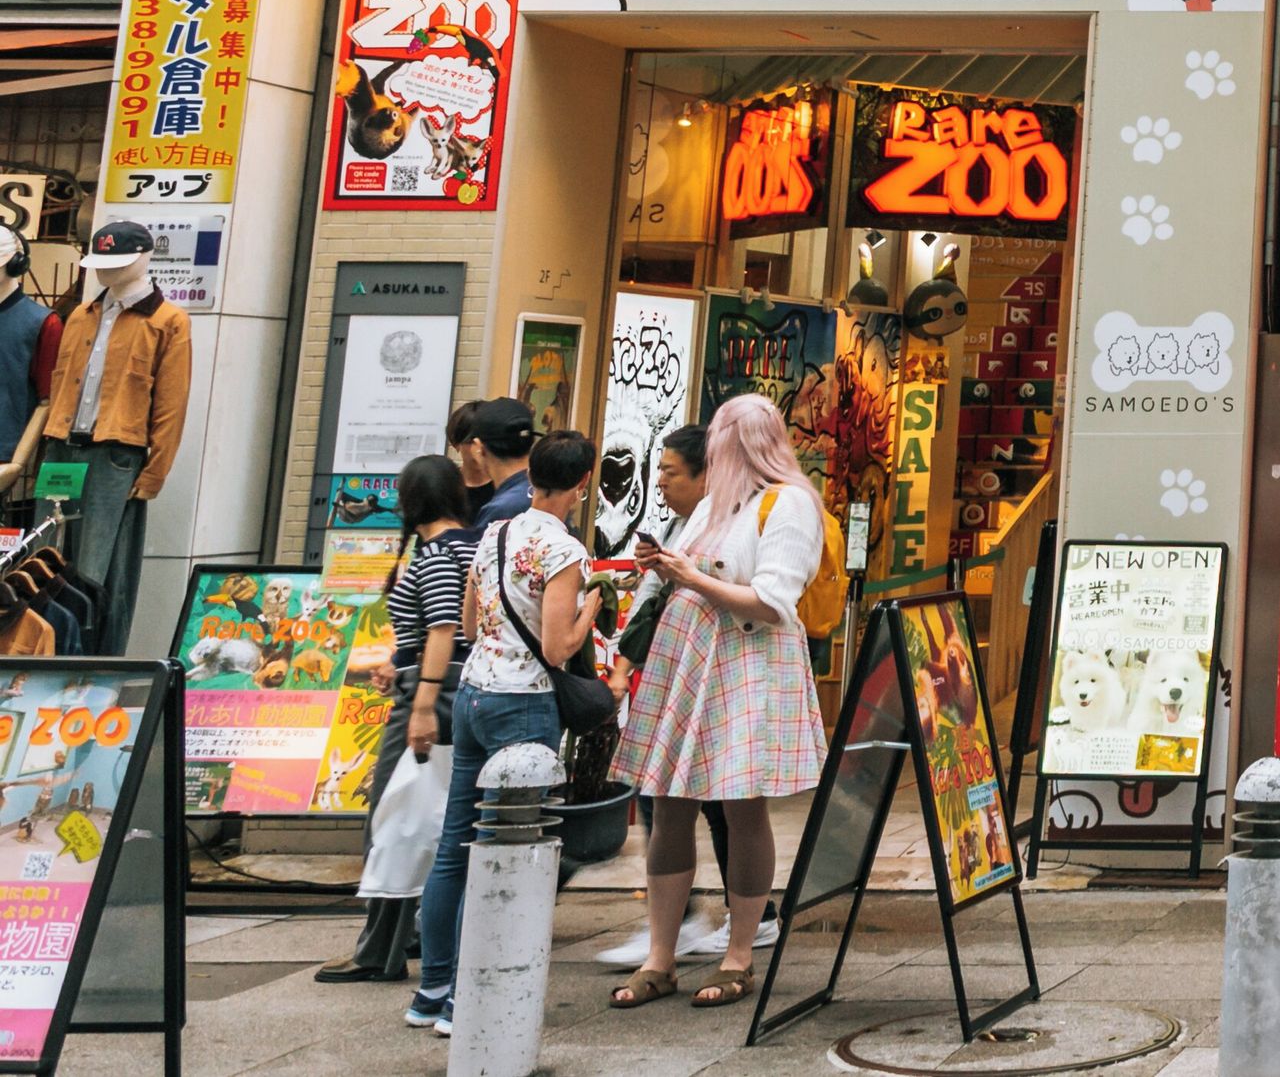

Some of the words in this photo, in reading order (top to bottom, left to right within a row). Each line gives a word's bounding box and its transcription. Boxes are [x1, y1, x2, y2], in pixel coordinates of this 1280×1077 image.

[892, 100, 1046, 144] Rare
[114, 142, 235, 168] 使い方自由
[127, 173, 213, 200] アップ
[865, 140, 1069, 222] ZOO
[372, 283, 421, 295] ASUKA
[424, 286, 449, 295] BLD.
[539, 269, 551, 283] 2F
[1085, 397, 1234, 413] SAMOEDO'S
[890, 389, 937, 575] SALE
[1096, 550, 1145, 569] NEW
[198, 615, 264, 642] Rare
[30, 706, 131, 746] ZOO
